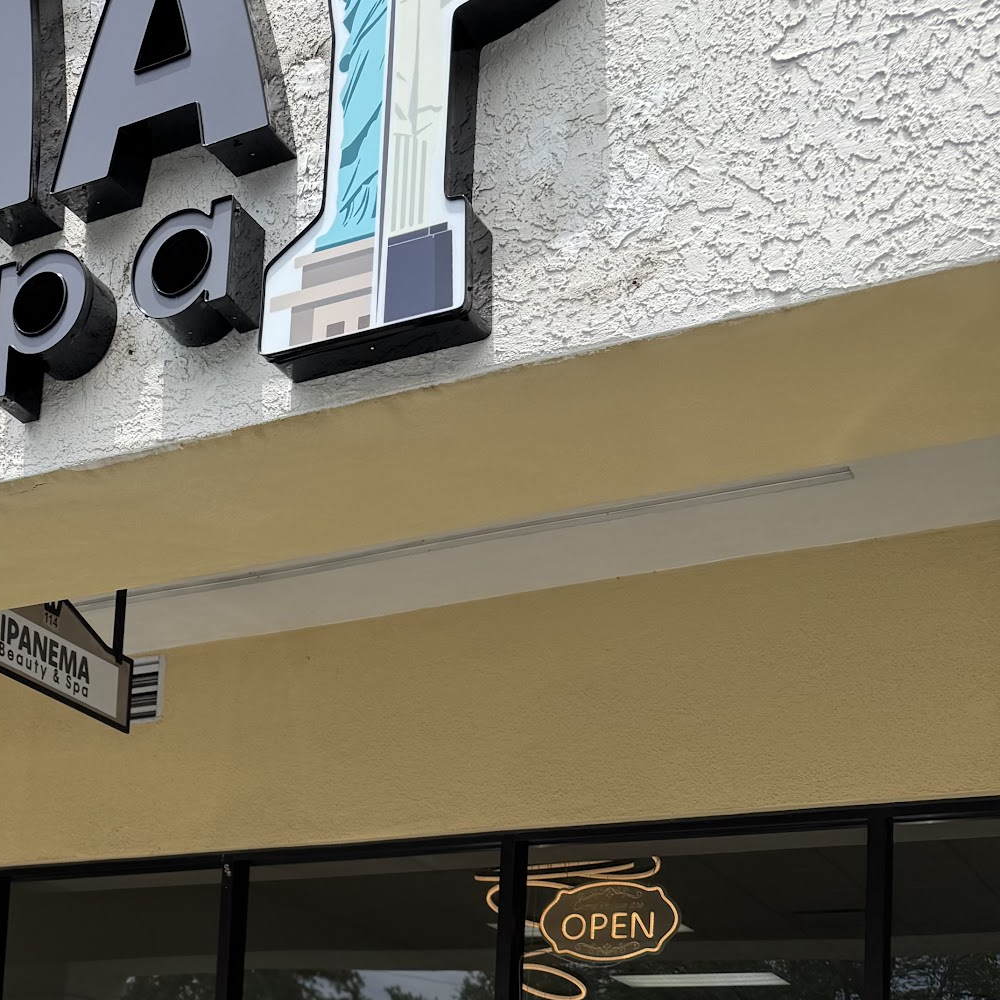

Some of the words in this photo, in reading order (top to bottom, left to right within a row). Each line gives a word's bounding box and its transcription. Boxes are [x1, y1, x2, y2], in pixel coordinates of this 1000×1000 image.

[44, 612, 58, 628] 114
[0, 614, 90, 684] IPANEMA
[0, 641, 47, 680] Beauty
[52, 668, 60, 685] &
[66, 677, 88, 698] Spa
[561, 911, 655, 940] OPEN
